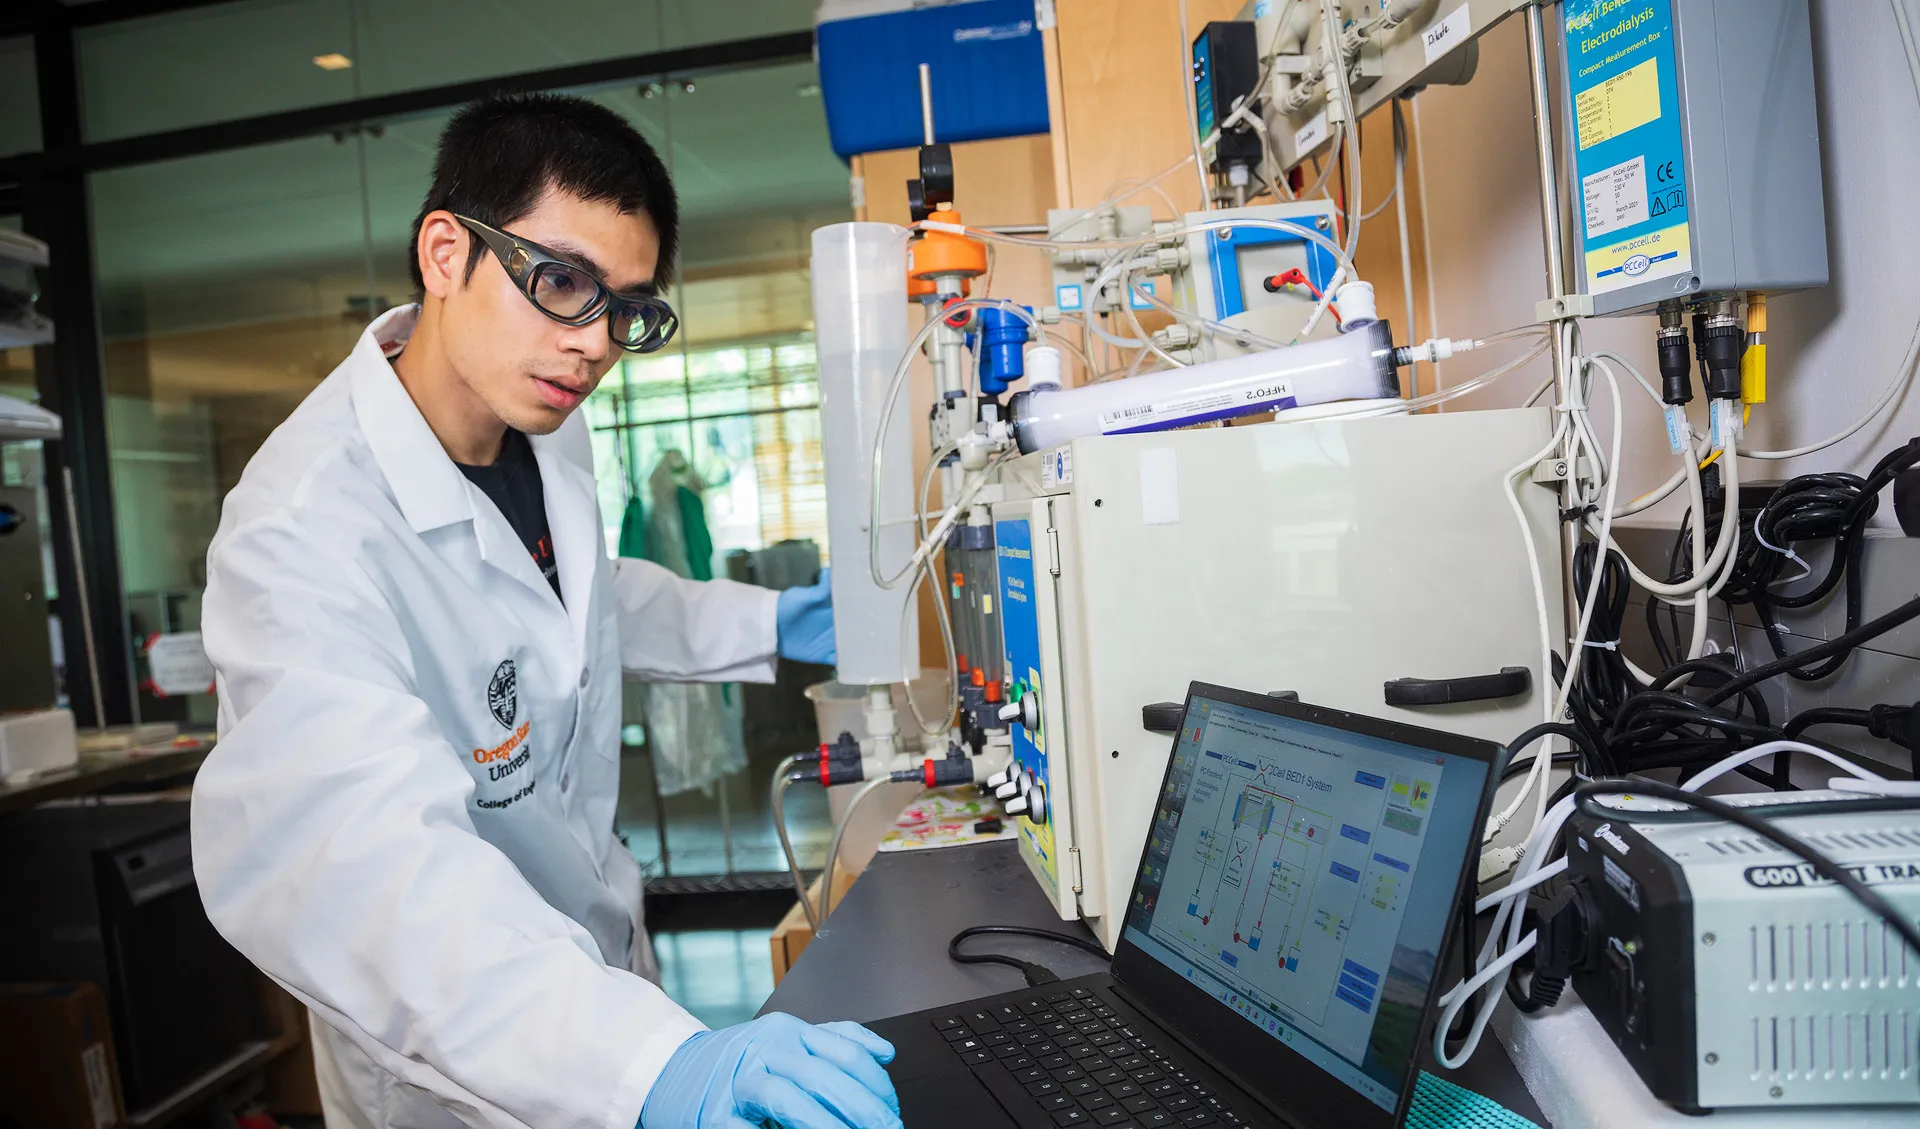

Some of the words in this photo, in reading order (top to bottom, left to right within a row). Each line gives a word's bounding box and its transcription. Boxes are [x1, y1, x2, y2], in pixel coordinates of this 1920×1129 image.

[1581, 7, 1654, 54] Electrodialysis
[1578, 60, 1605, 78] Compact
[1606, 37, 1648, 65] Measurement
[1648, 32, 1661, 42] Box
[1612, 167, 1626, 176] PCCell
[1611, 234, 1660, 254] www.pccell.de
[1624, 259, 1648, 272] PCCell
[473, 734, 518, 764] Oregon
[1286, 770, 1306, 784] BED1
[1306, 778, 1333, 794] System
[477, 797, 512, 810] College
[514, 789, 522, 802] of
[1751, 868, 1798, 886] 600
